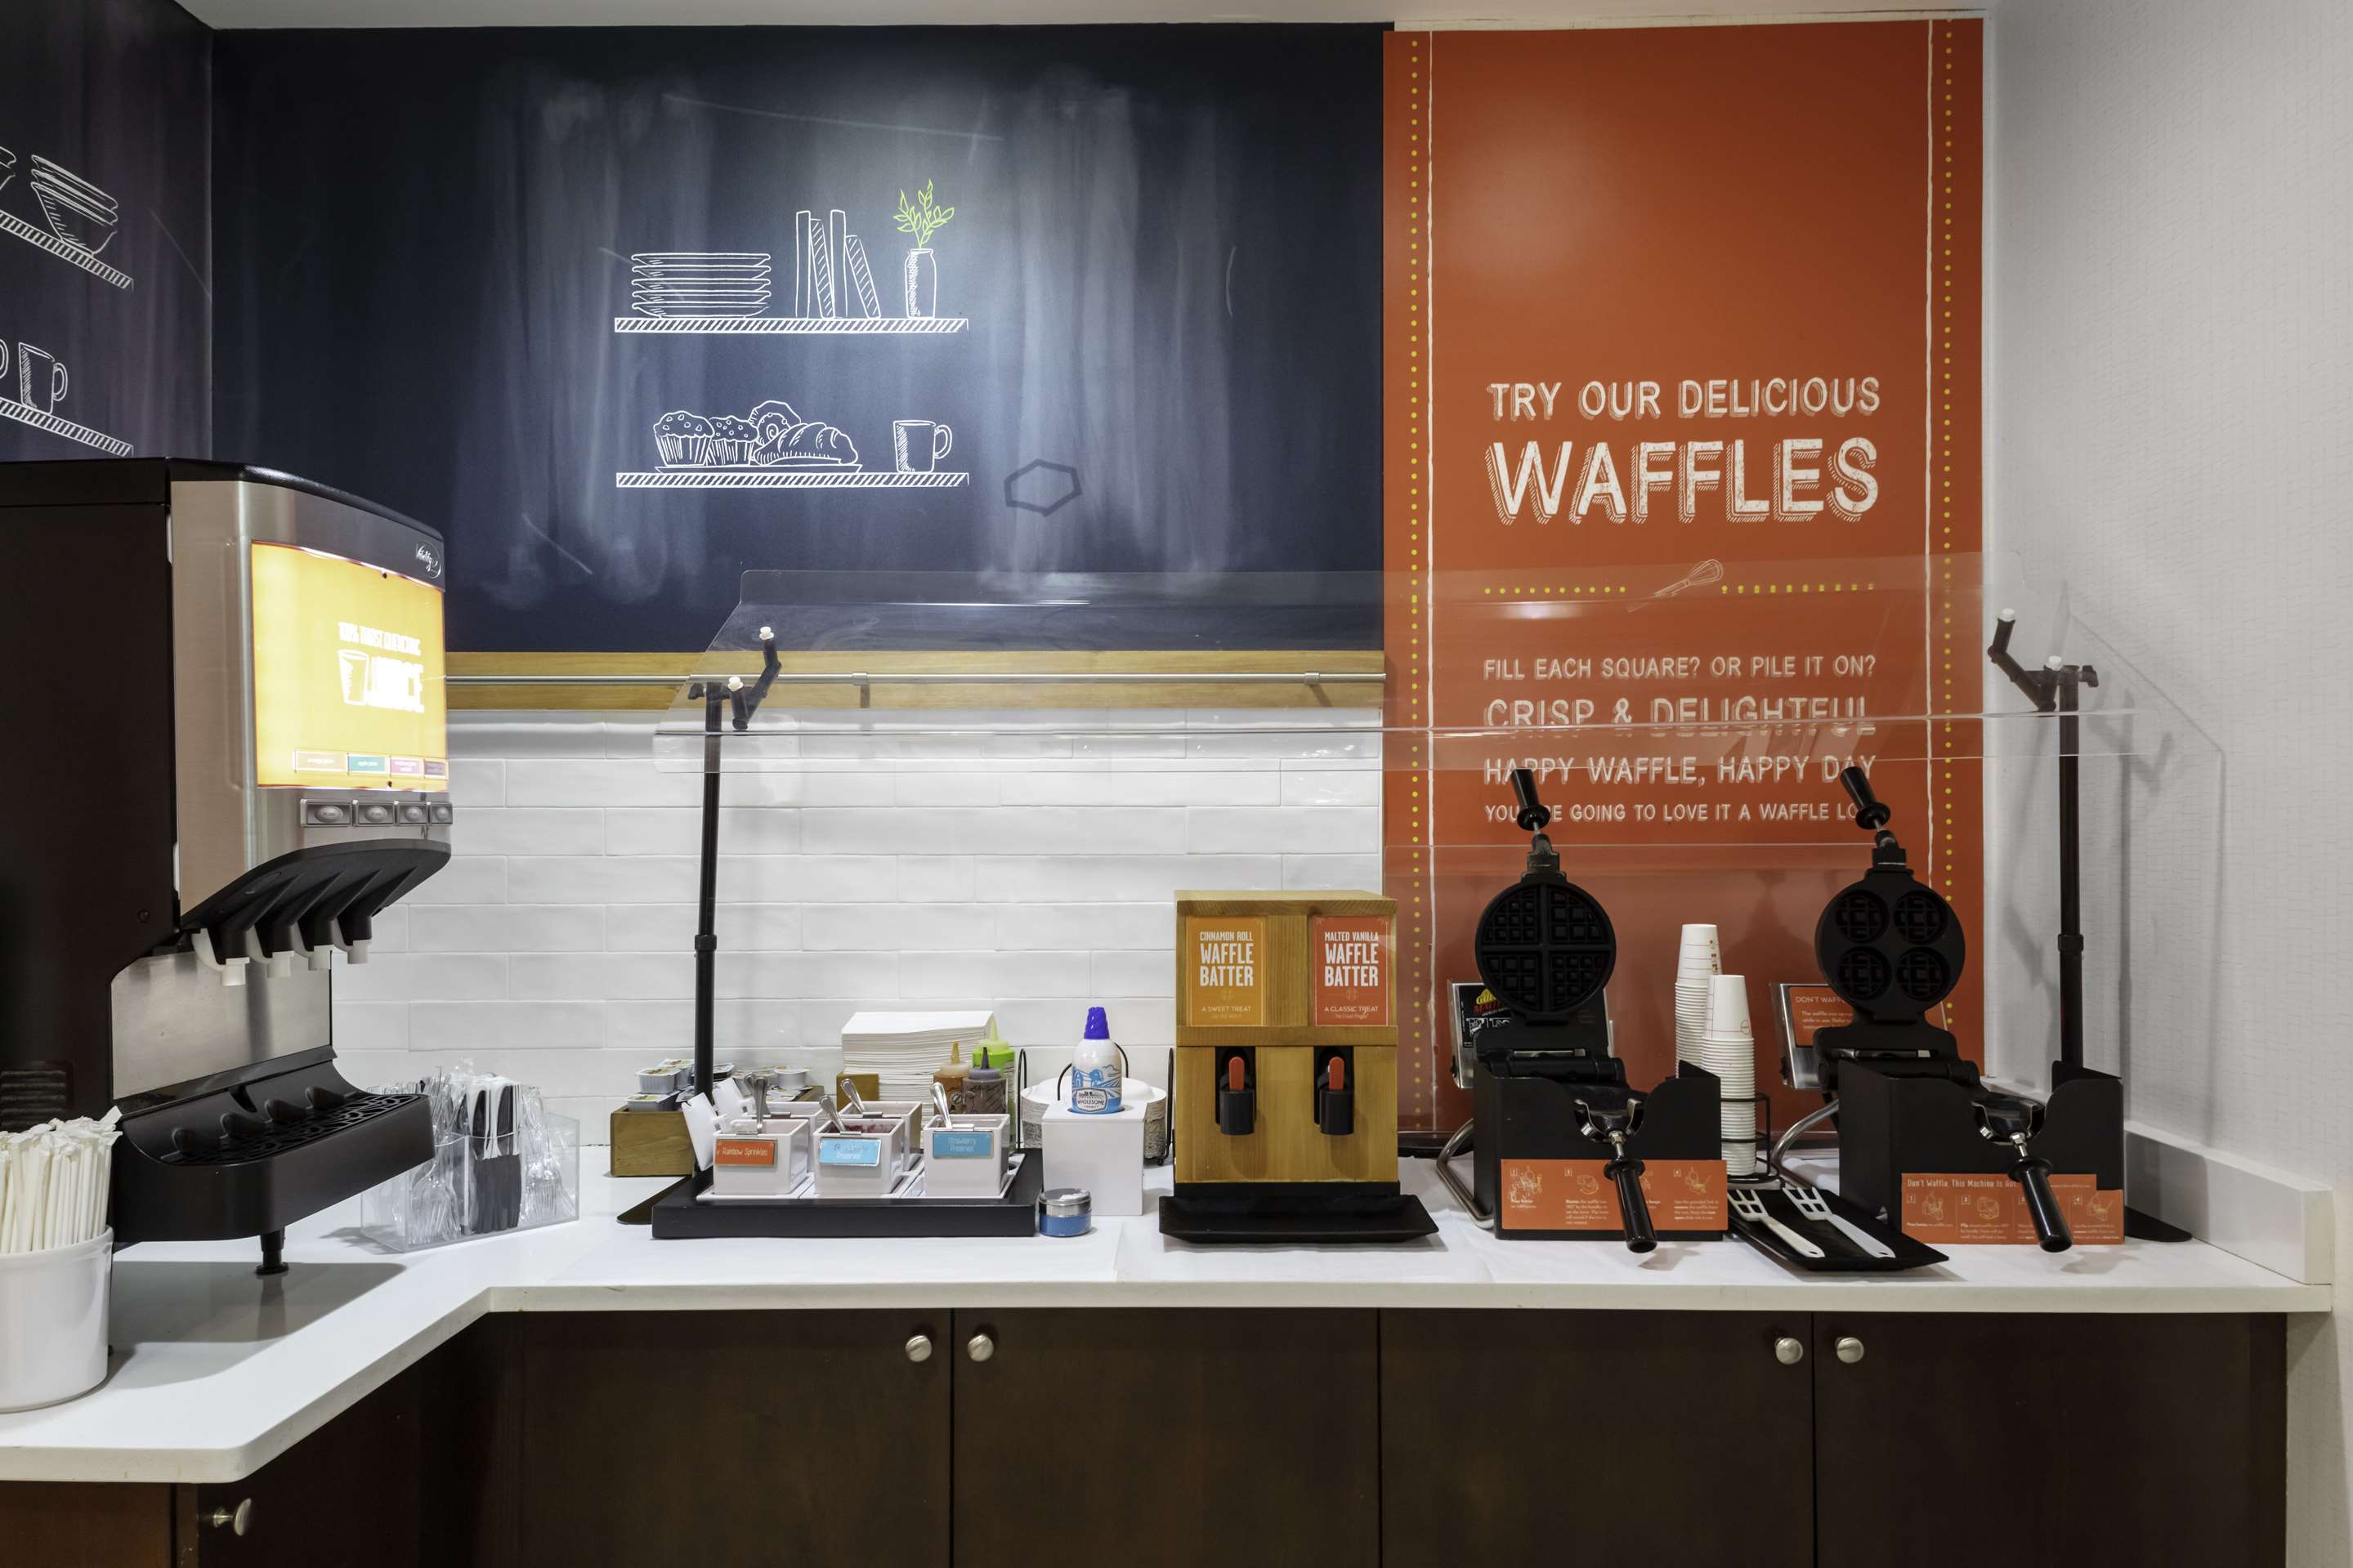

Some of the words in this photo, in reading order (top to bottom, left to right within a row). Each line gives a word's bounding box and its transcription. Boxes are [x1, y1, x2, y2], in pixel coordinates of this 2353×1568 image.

[1487, 382, 1562, 421] TRY
[1579, 380, 1662, 421] OUR
[1678, 377, 1880, 419] DELICIOUS
[1485, 436, 1879, 525] WAFFLES
[1484, 658, 1525, 680] FILL
[1535, 657, 1591, 680] EACH
[1601, 656, 1701, 679] SQUARE?
[1711, 655, 1742, 677] OR
[1751, 655, 1796, 677] PILE
[1805, 655, 1823, 677] IT
[1833, 654, 1876, 677] ON?
[1484, 699, 1595, 737] CRISP
[1613, 698, 1632, 737] &
[1650, 696, 1876, 736] DELIGHTFUL
[1587, 757, 1705, 788] WAFFLE,
[1718, 755, 1809, 784] HAPPY
[1569, 804, 1626, 823] GOING
[1633, 804, 1656, 822] TO
[1663, 804, 1707, 822] LOVE
[1716, 804, 1731, 821] IT
[1738, 804, 1751, 821] A
[1760, 804, 1829, 821] WAFFLE
[1200, 931, 1235, 941] CINNAMON
[1237, 931, 1254, 941] ROLL
[1324, 931, 1350, 941] MALTED
[1352, 931, 1379, 941] VANILLA
[1200, 943, 1254, 964] WAFFLE
[1325, 943, 1379, 964] WAFFLE
[1200, 966, 1254, 987] BATTER
[1325, 966, 1379, 987] BATTER
[722, 1147, 743, 1155] Rainbow
[745, 1147, 768, 1157] Sprinkles
[1952, 1179, 1966, 1187] This
[1967, 1179, 1994, 1188] Machine
